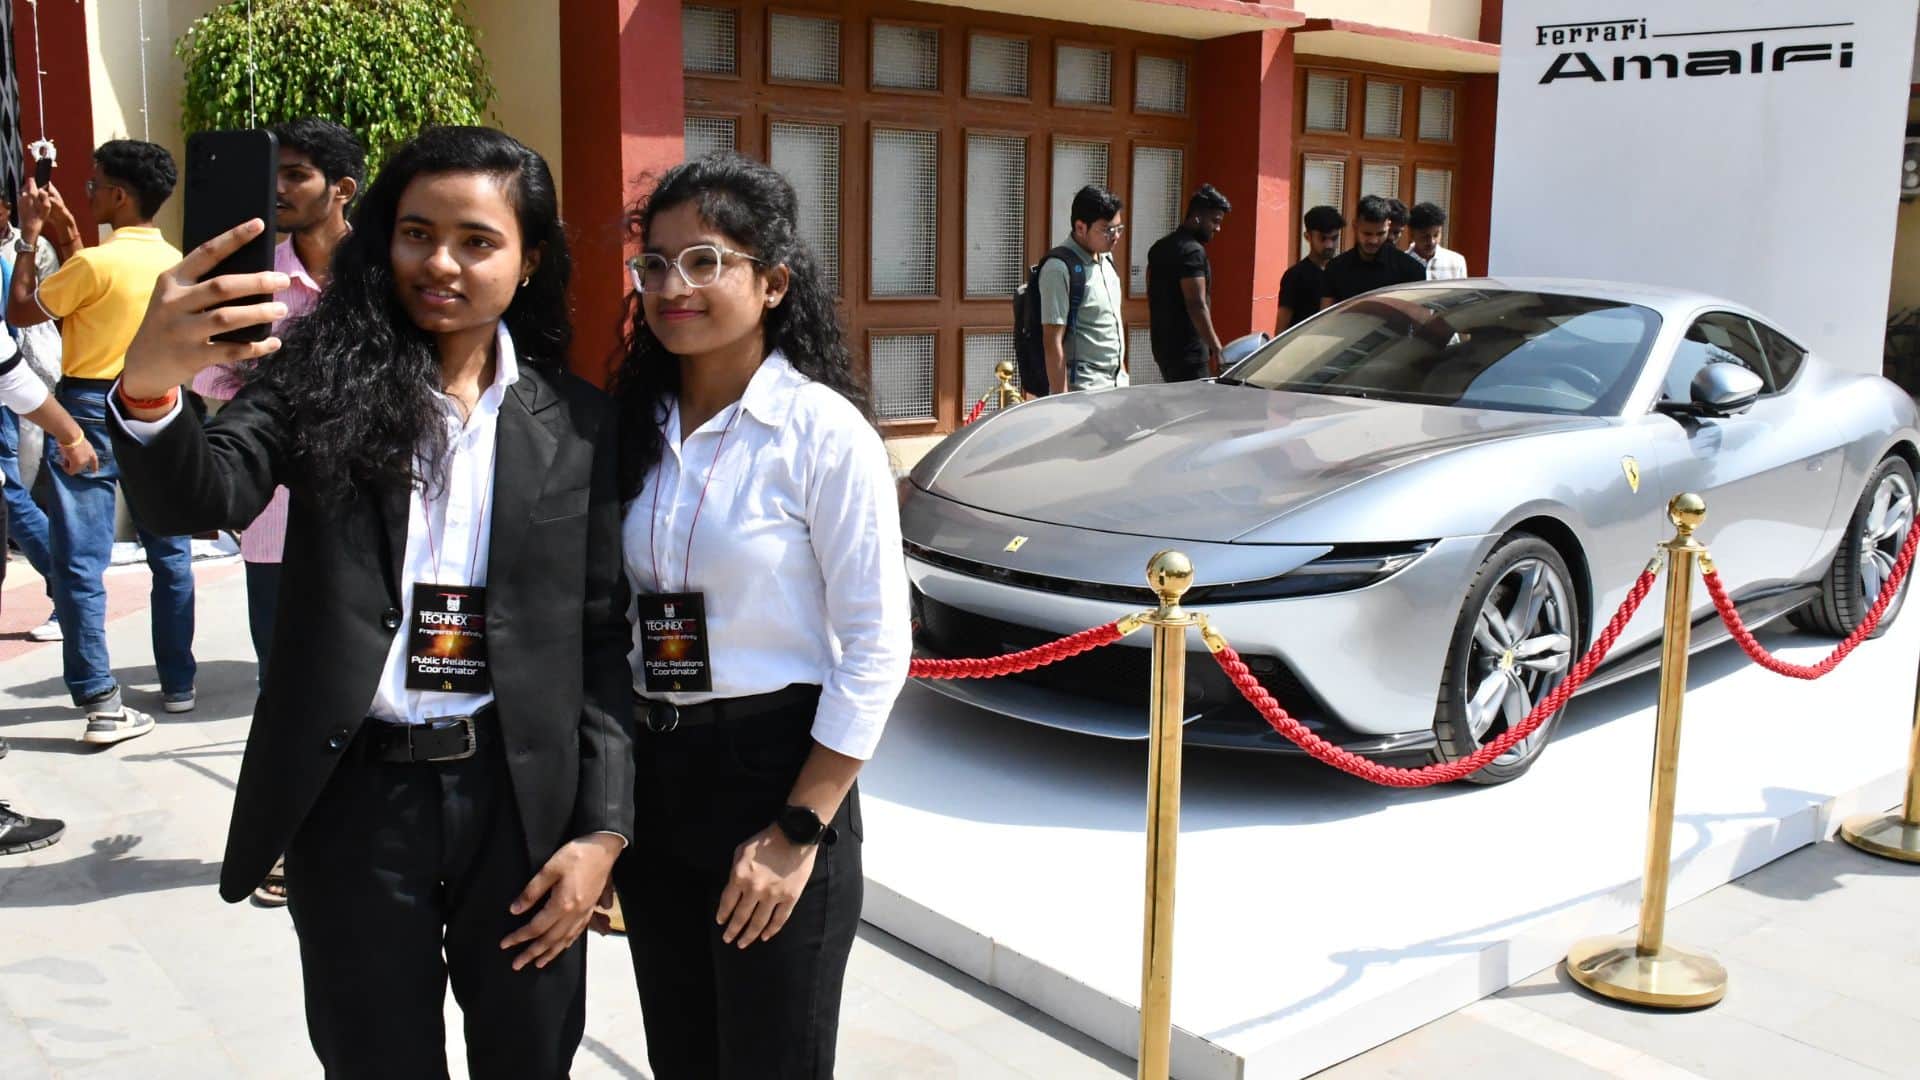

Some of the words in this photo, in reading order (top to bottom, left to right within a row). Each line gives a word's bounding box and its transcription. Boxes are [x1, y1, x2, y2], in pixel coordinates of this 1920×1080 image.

[1535, 18, 1647, 46] Ferrari
[420, 613, 468, 626] TECHNEX
[646, 620, 683, 631] TECHNEX
[411, 656, 440, 665] Public
[442, 657, 486, 667] Relations
[646, 660, 668, 668] Public
[669, 660, 704, 668] Relations
[418, 664, 478, 675] Coordinator
